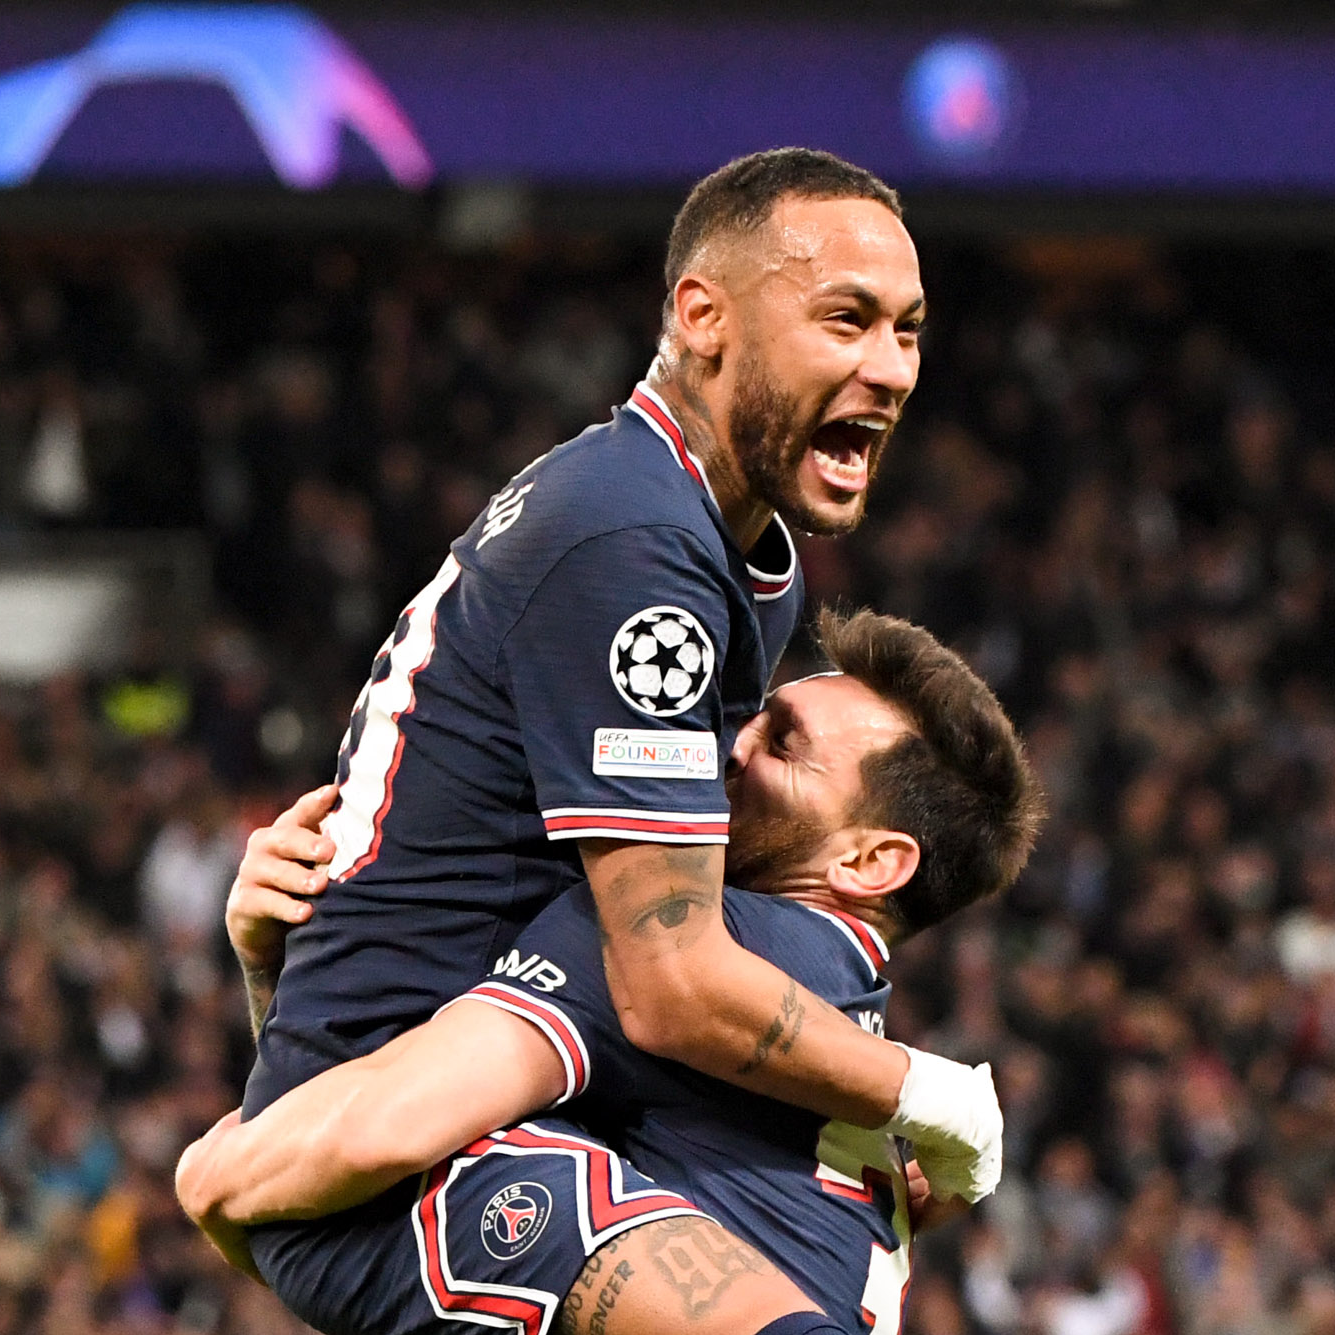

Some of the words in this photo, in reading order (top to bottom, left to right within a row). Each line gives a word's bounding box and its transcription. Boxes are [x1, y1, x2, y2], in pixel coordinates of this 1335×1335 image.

[598, 732, 630, 743] UEFA
[598, 744, 716, 763] FOUNDATION
[483, 1186, 522, 1232] PARIS
